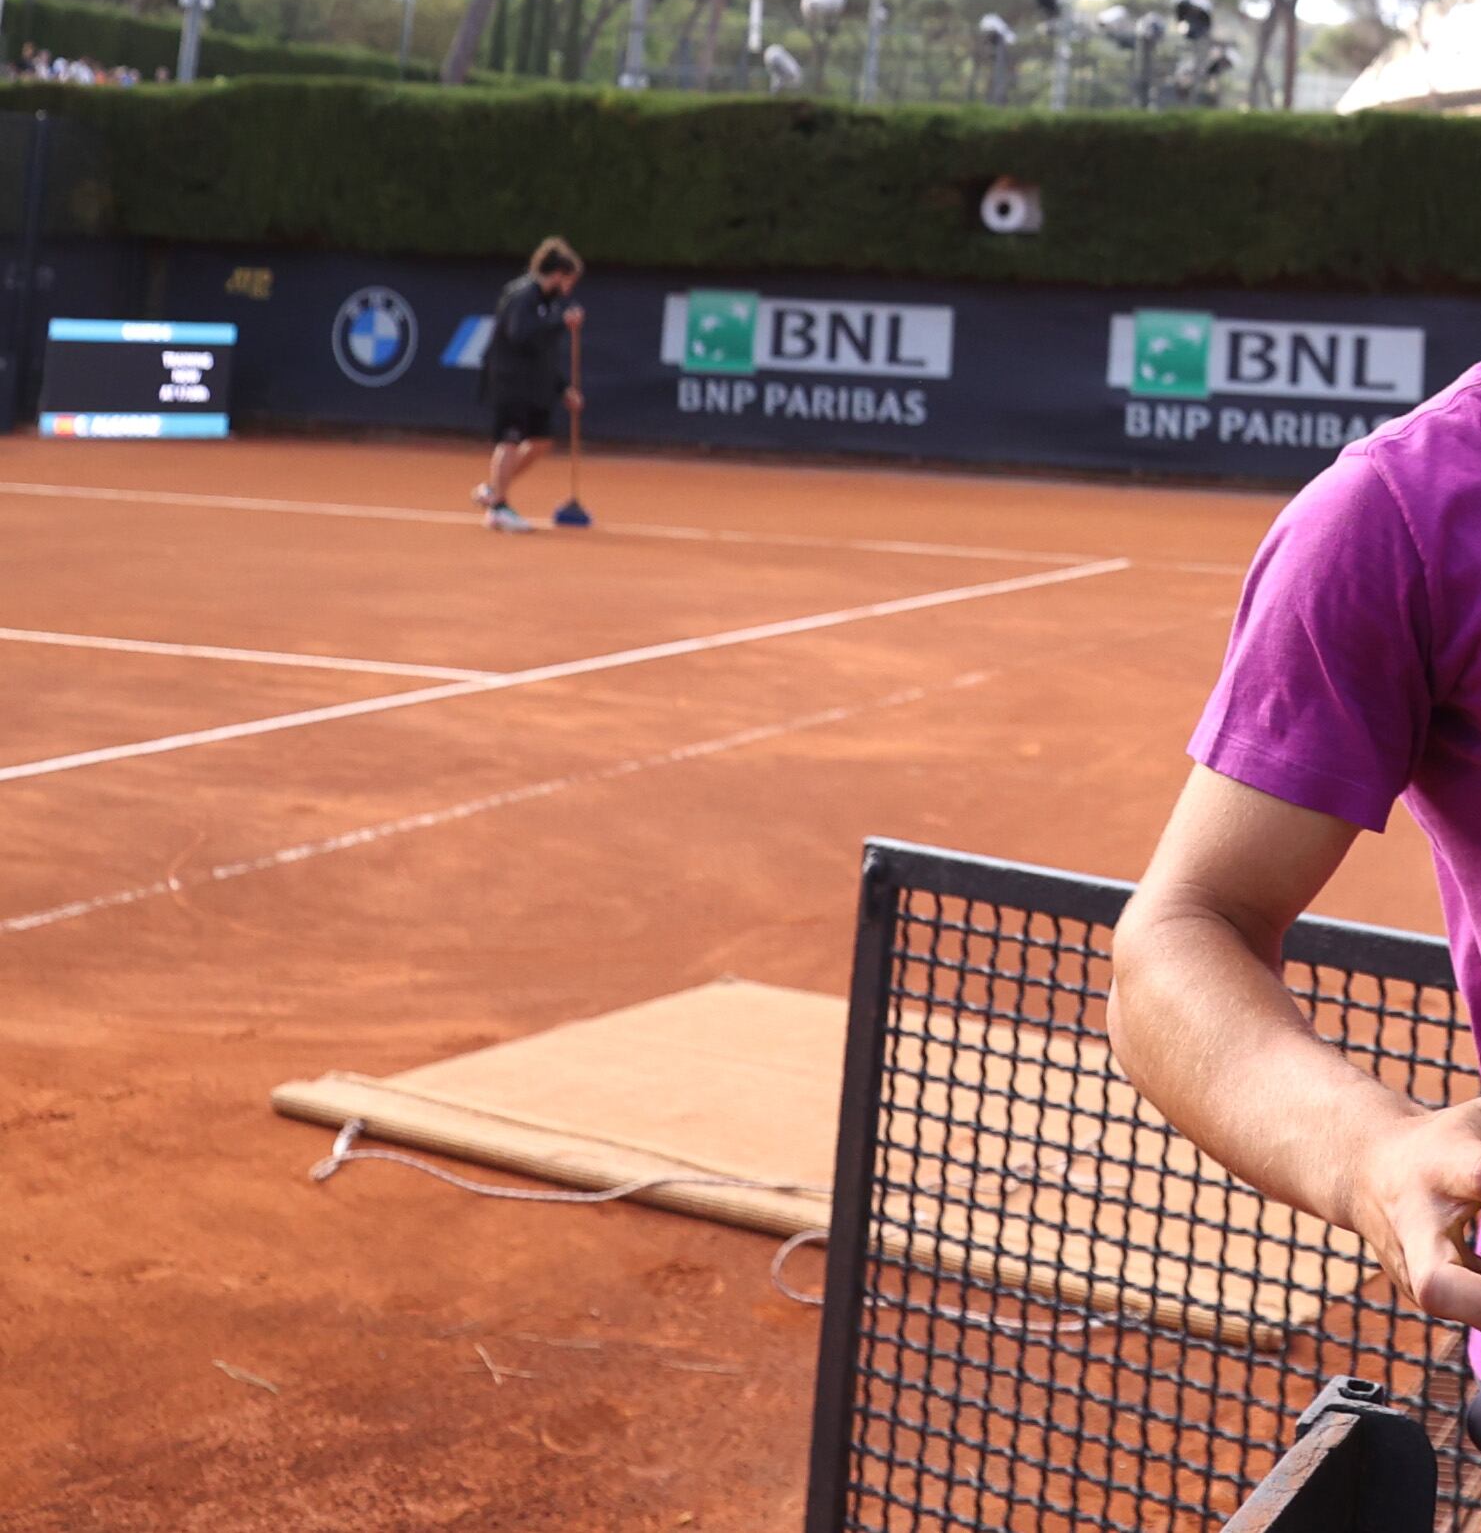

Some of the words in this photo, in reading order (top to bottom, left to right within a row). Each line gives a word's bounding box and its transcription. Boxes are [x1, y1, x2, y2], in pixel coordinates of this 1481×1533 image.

[769, 308, 926, 368] BNL
[1226, 330, 1396, 391] BNL
[677, 377, 757, 414] BNP
[763, 382, 928, 426] PARIBAS
[1124, 402, 1211, 439] BNP
